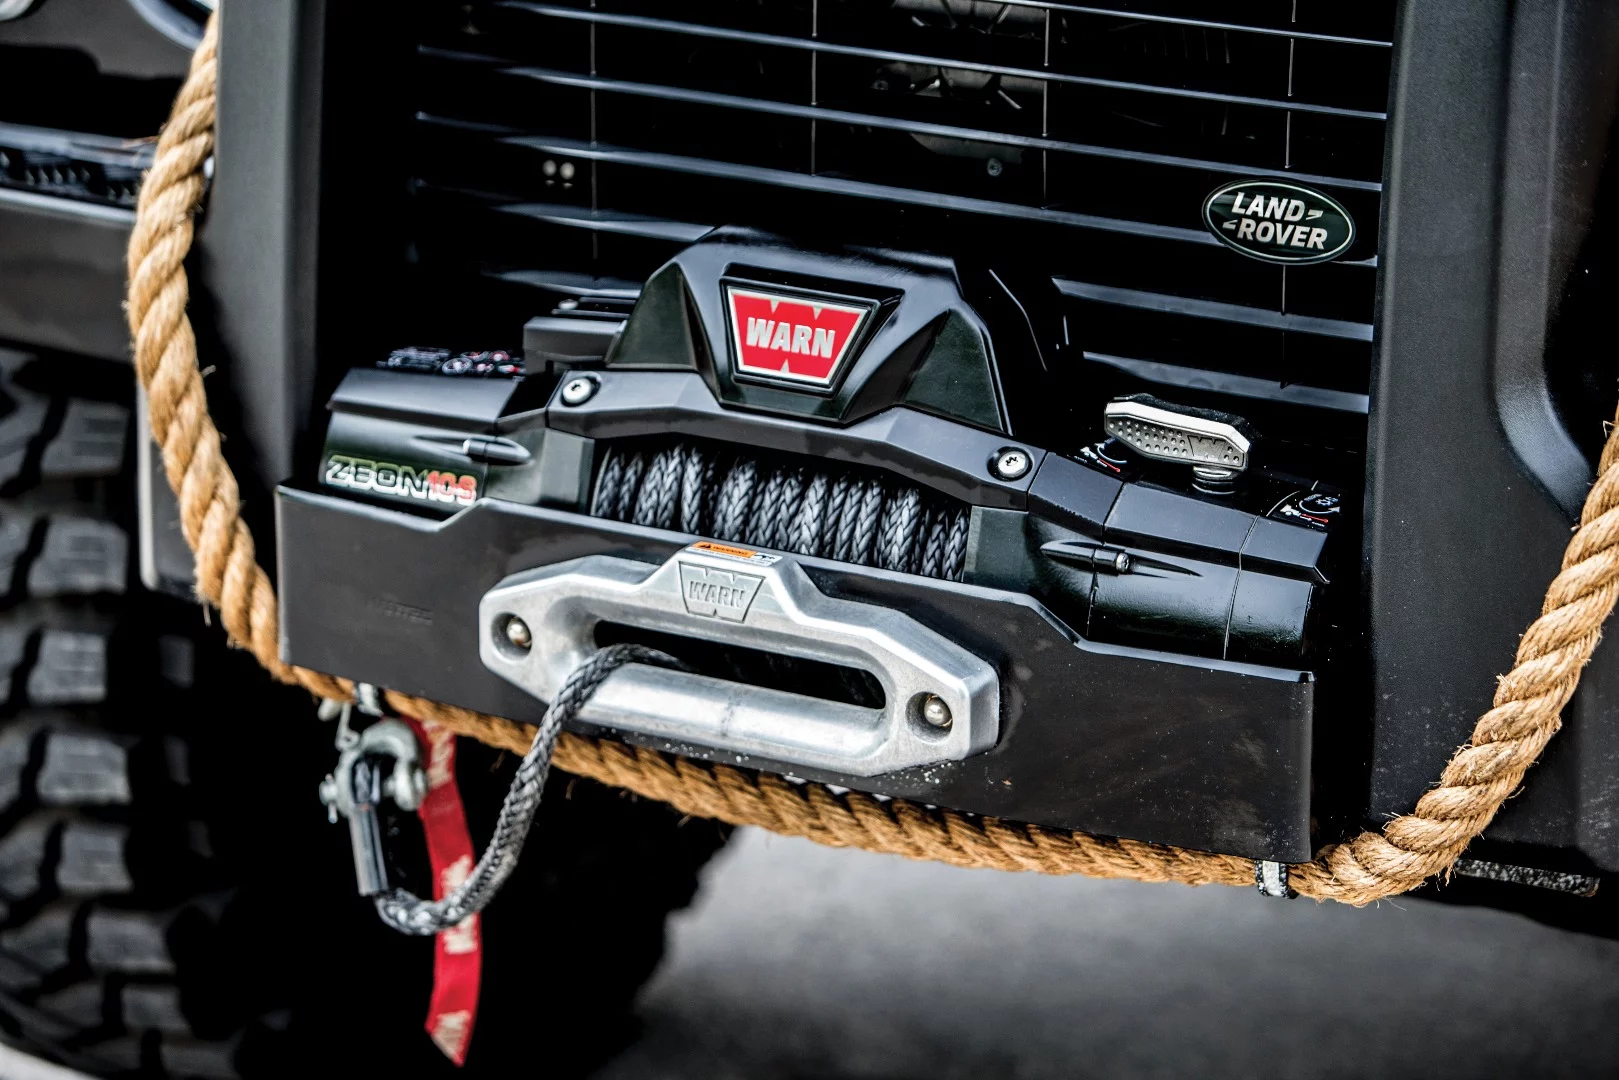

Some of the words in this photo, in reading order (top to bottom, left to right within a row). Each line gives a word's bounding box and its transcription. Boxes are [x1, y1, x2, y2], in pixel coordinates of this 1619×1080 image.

[1231, 191, 1306, 222] LAND
[1236, 217, 1328, 250] ROVER
[746, 316, 836, 359] WARN
[688, 580, 746, 608] WARN
